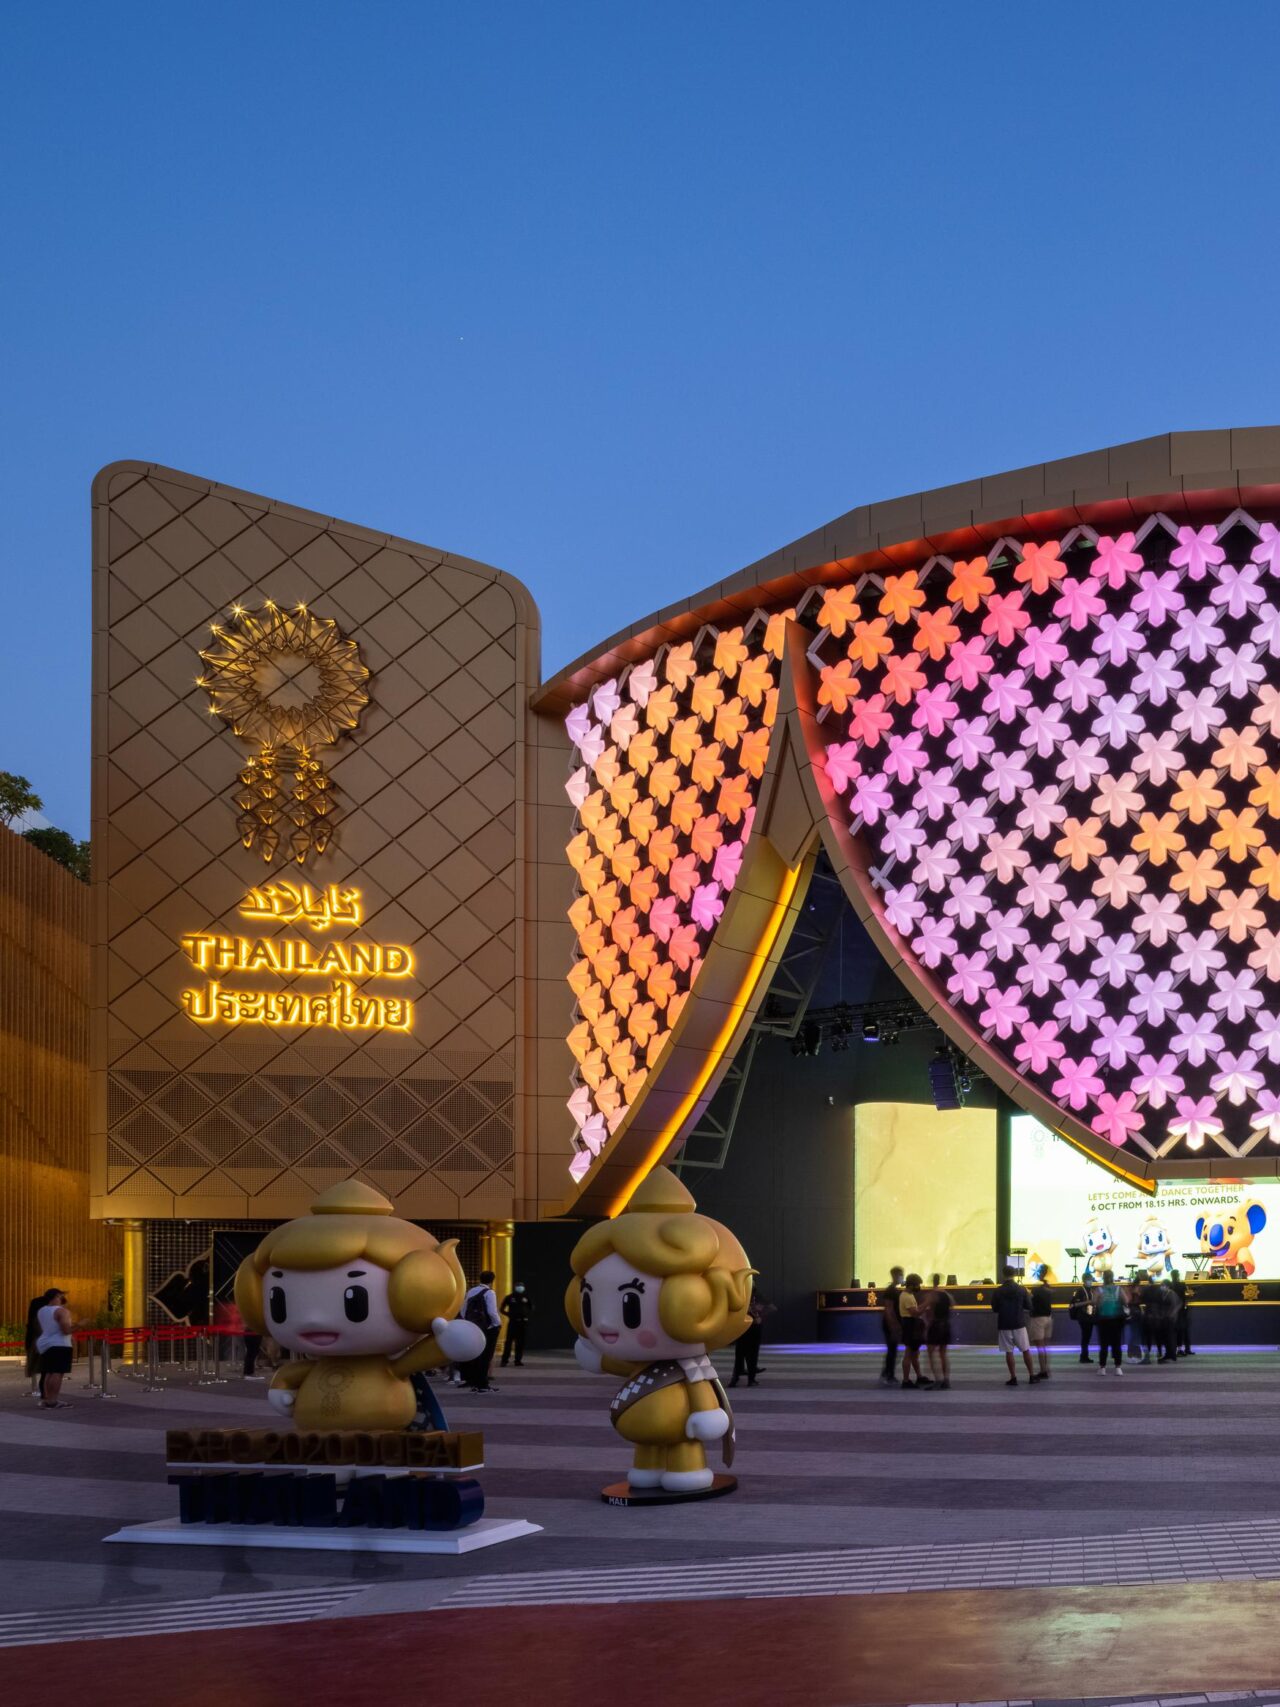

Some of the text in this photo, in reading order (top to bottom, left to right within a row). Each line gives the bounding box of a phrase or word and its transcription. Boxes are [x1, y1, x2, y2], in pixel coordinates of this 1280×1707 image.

[239, 882, 360, 928] تايلاند
[181, 933, 413, 976] THAILAND
[181, 980, 414, 1028] ประเทศไทย
[1088, 1191, 1110, 1201] LET'S
[1112, 1190, 1137, 1200] COME
[1161, 1187, 1193, 1197] DANCE
[1195, 1184, 1244, 1195] TOGETHER
[1091, 1195, 1241, 1211] 6 OCT FROM 18.15 HRS. ONWARDS.
[166, 1430, 260, 1463] EXPO
[264, 1431, 347, 1465] 2020
[167, 1471, 485, 1532] THAILAND
[608, 1495, 628, 1507] MALI
